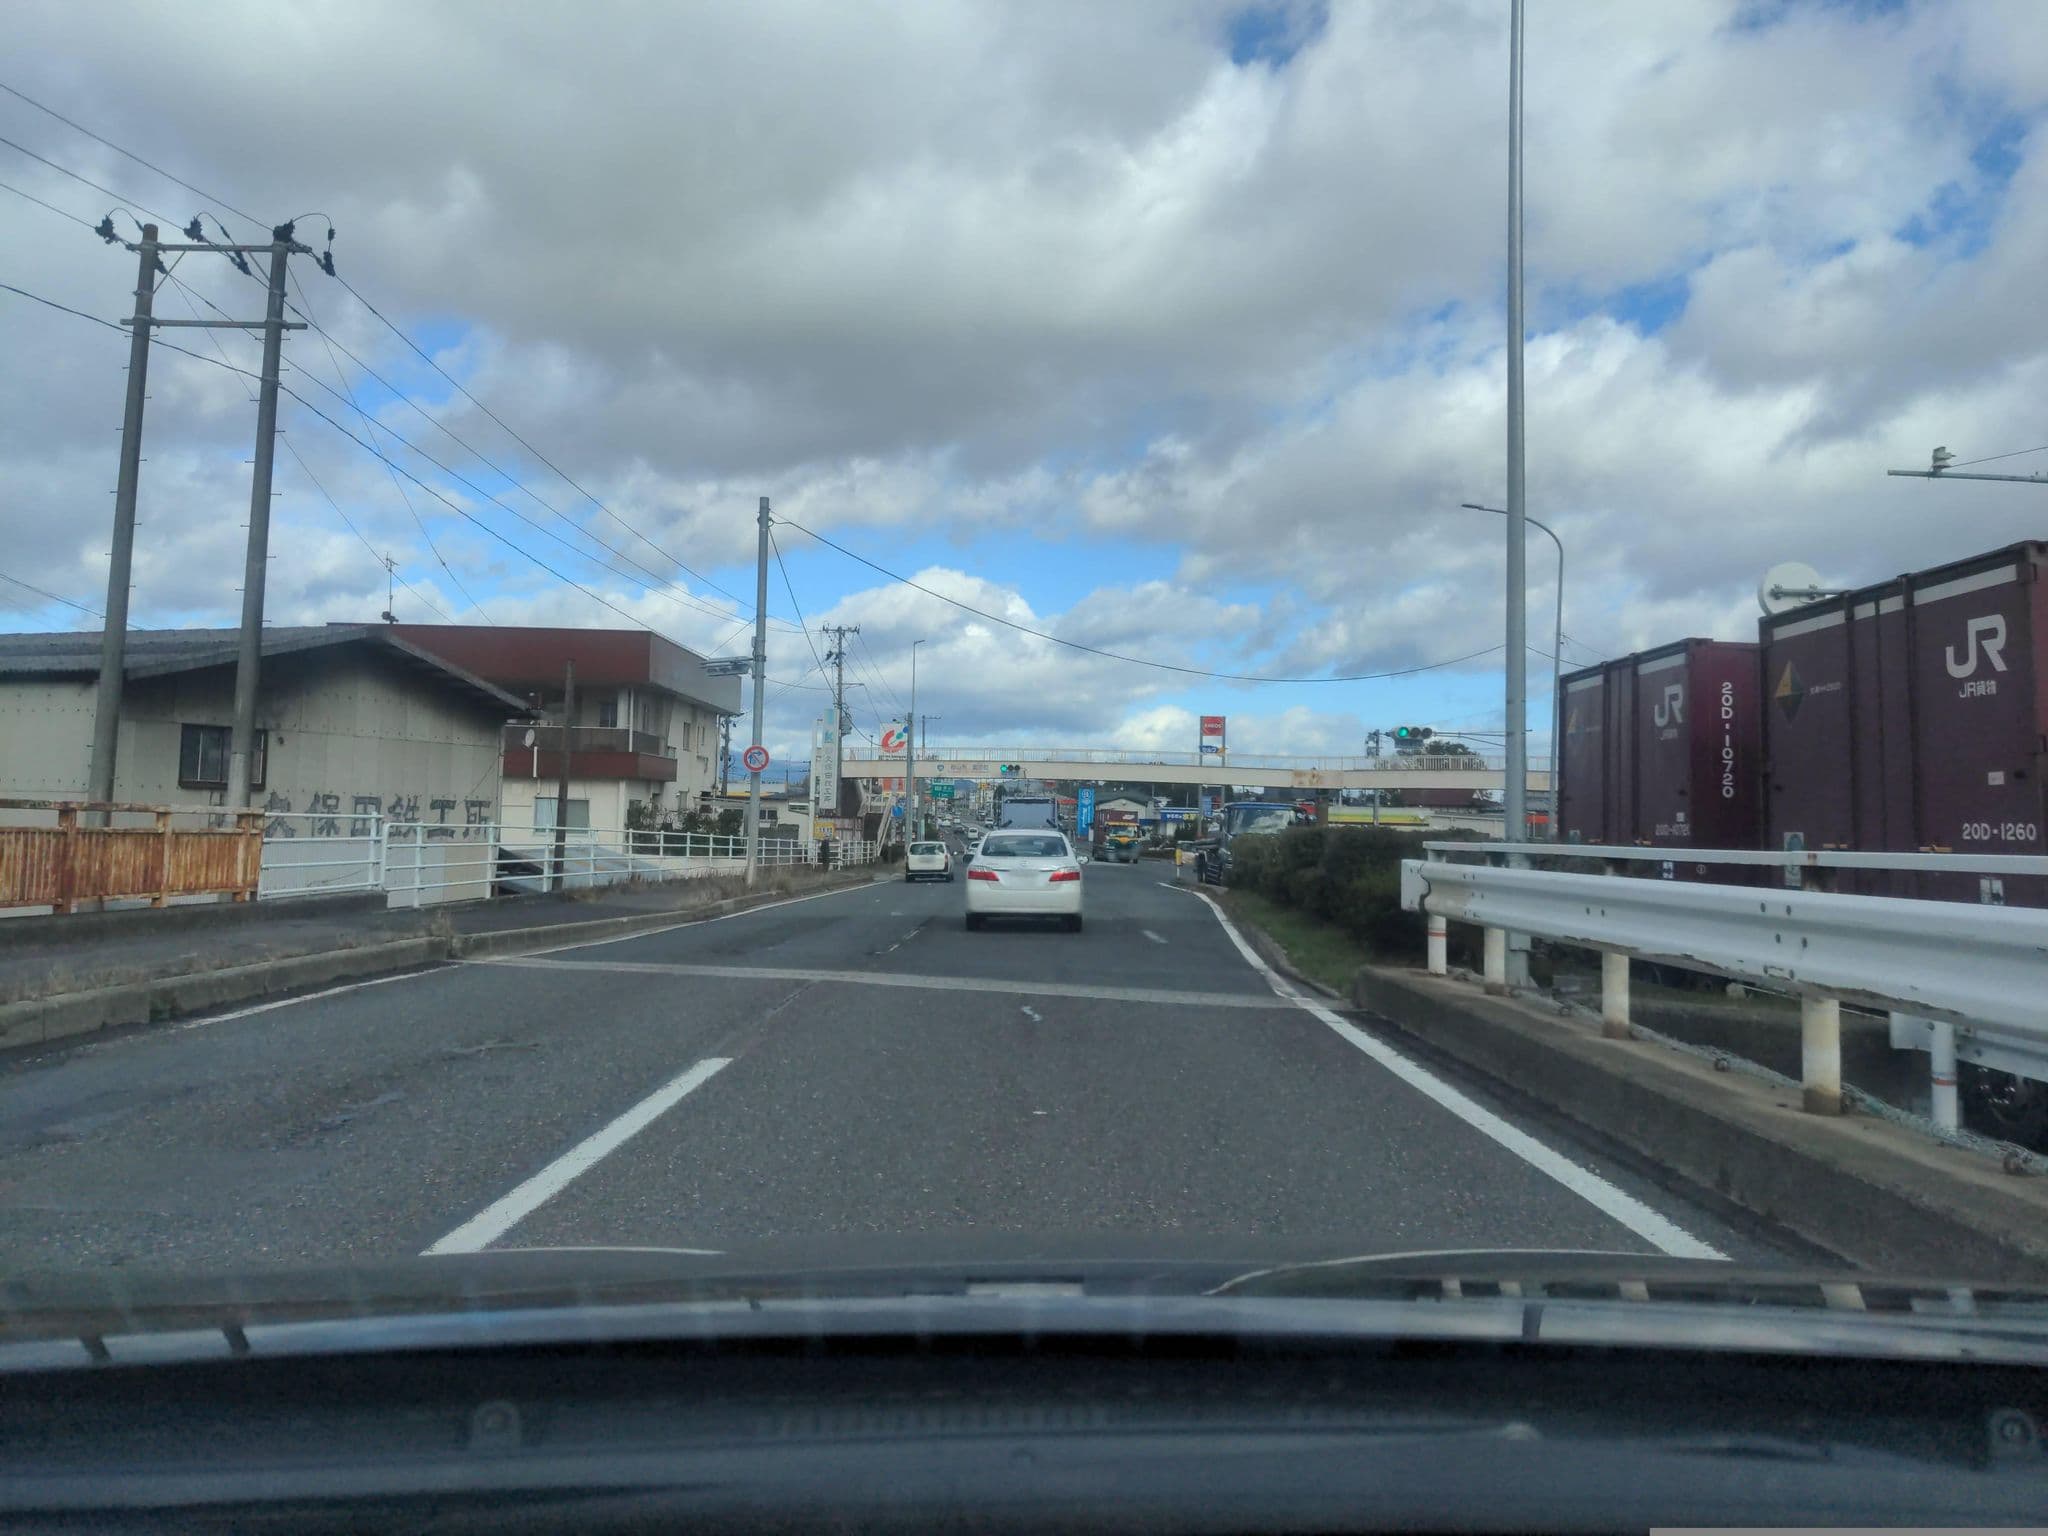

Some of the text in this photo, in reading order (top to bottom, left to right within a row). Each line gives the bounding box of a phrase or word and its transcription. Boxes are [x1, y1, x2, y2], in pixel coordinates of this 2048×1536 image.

[1945, 613, 2008, 679] JR
[1654, 684, 1683, 727] JR
[1958, 680, 1997, 698] JR貨物
